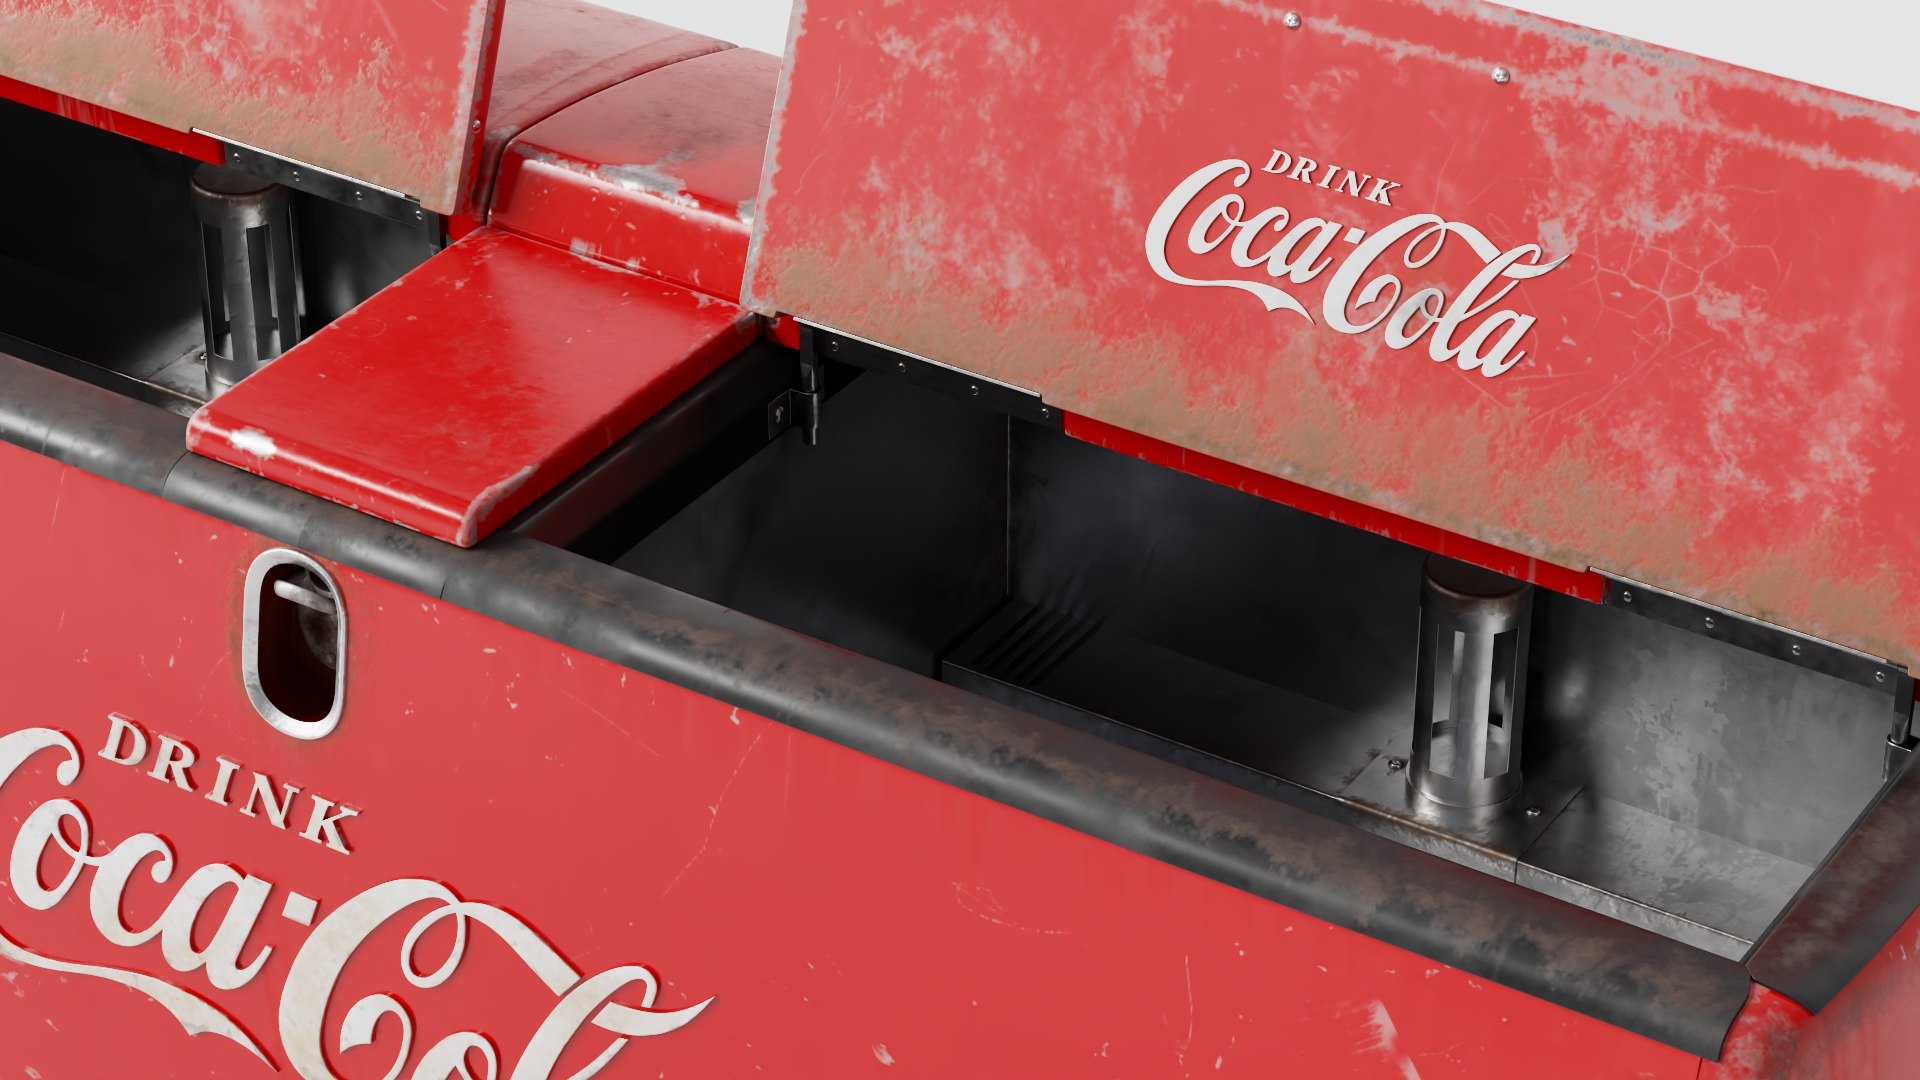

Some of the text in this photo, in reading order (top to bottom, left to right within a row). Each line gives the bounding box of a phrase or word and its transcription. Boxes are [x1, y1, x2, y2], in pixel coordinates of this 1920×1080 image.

[1262, 149, 1401, 206] DRINK
[1145, 159, 1571, 377] Coca-Cola
[98, 712, 362, 855] DRINK
